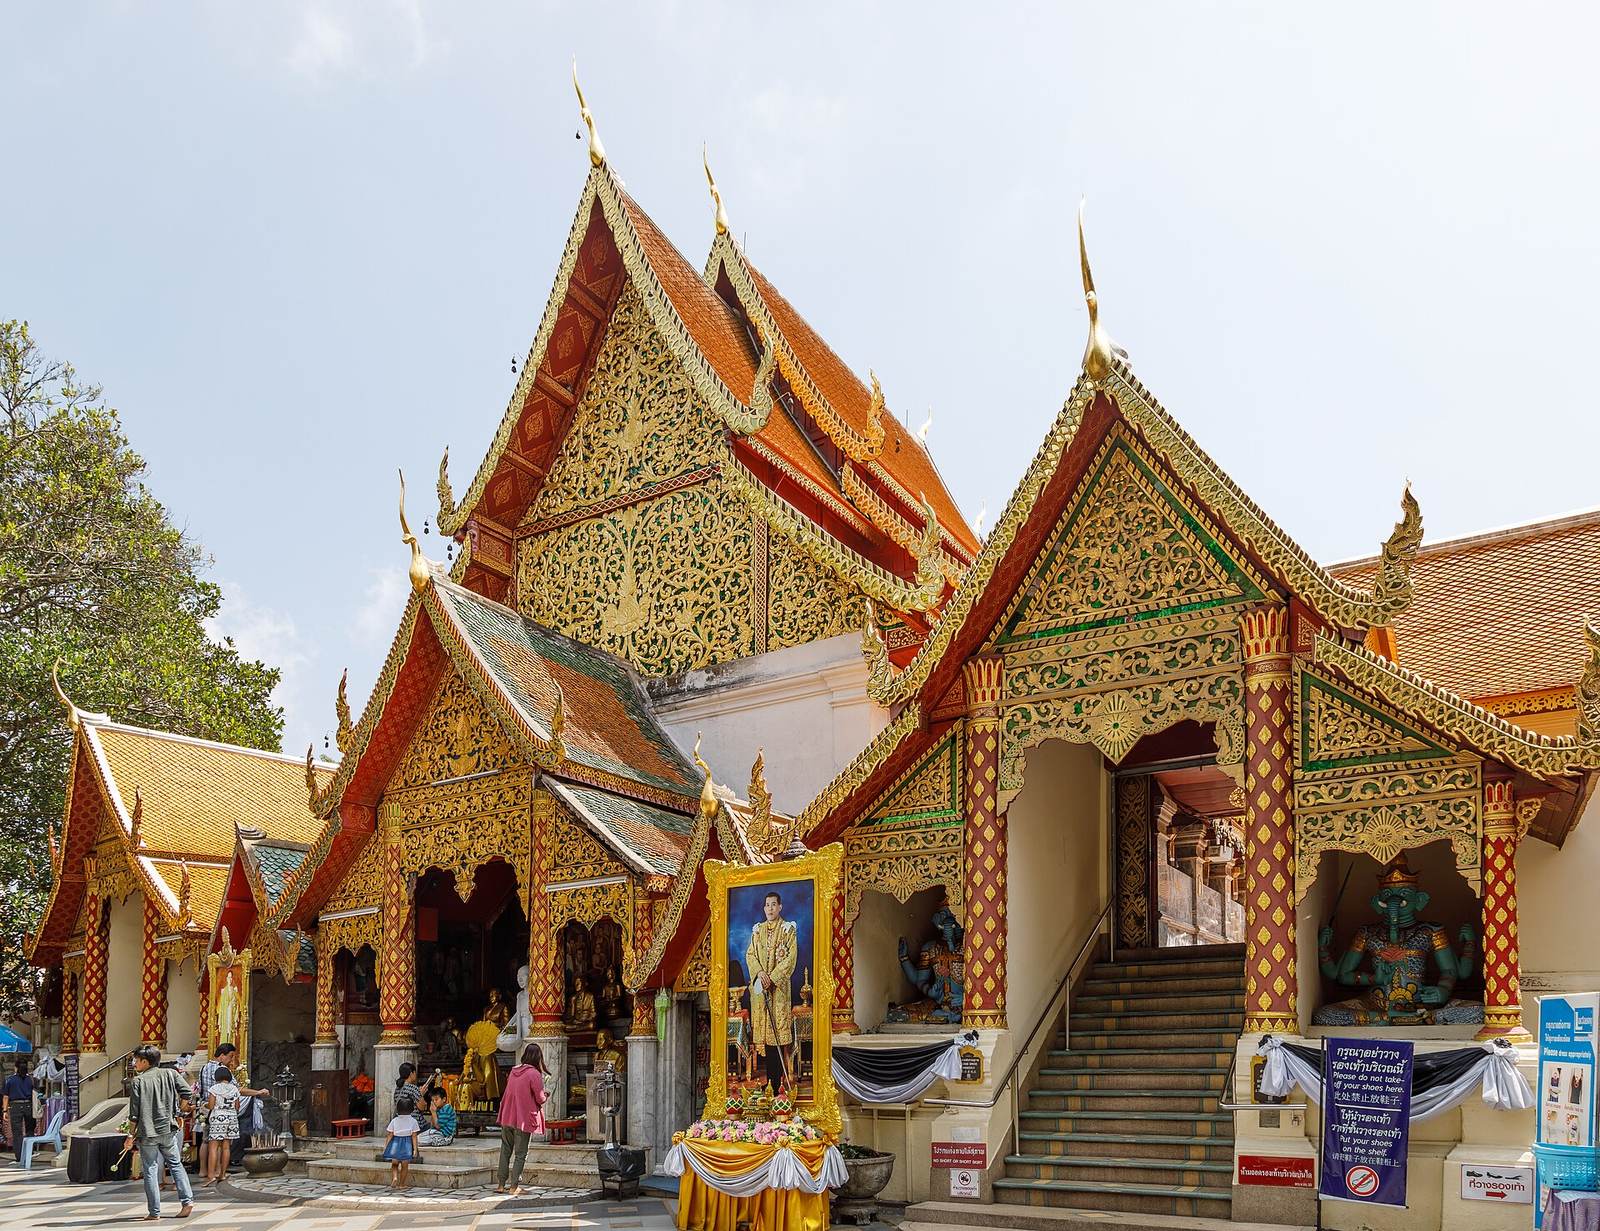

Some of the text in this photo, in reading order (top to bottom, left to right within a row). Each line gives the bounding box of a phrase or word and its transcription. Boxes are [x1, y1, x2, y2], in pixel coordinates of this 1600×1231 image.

[1336, 1046, 1400, 1060] กรุณาอย่าวาง
[1543, 1047, 1558, 1056] Please
[1332, 1059, 1408, 1074] รองเท้าบริเวณนี้
[1333, 1071, 1356, 1080] Please
[1358, 1073, 1368, 1081] do
[1370, 1075, 1383, 1083] not
[1333, 1080, 1405, 1093] off your shoes here.
[1340, 1109, 1391, 1125] ให้นำรองเท้า
[1340, 1134, 1393, 1148] Put your shoes
[1354, 1146, 1367, 1155] the
[1368, 1148, 1388, 1157] shelf.
[1469, 1177, 1525, 1191] ที่วางรองเท้า
